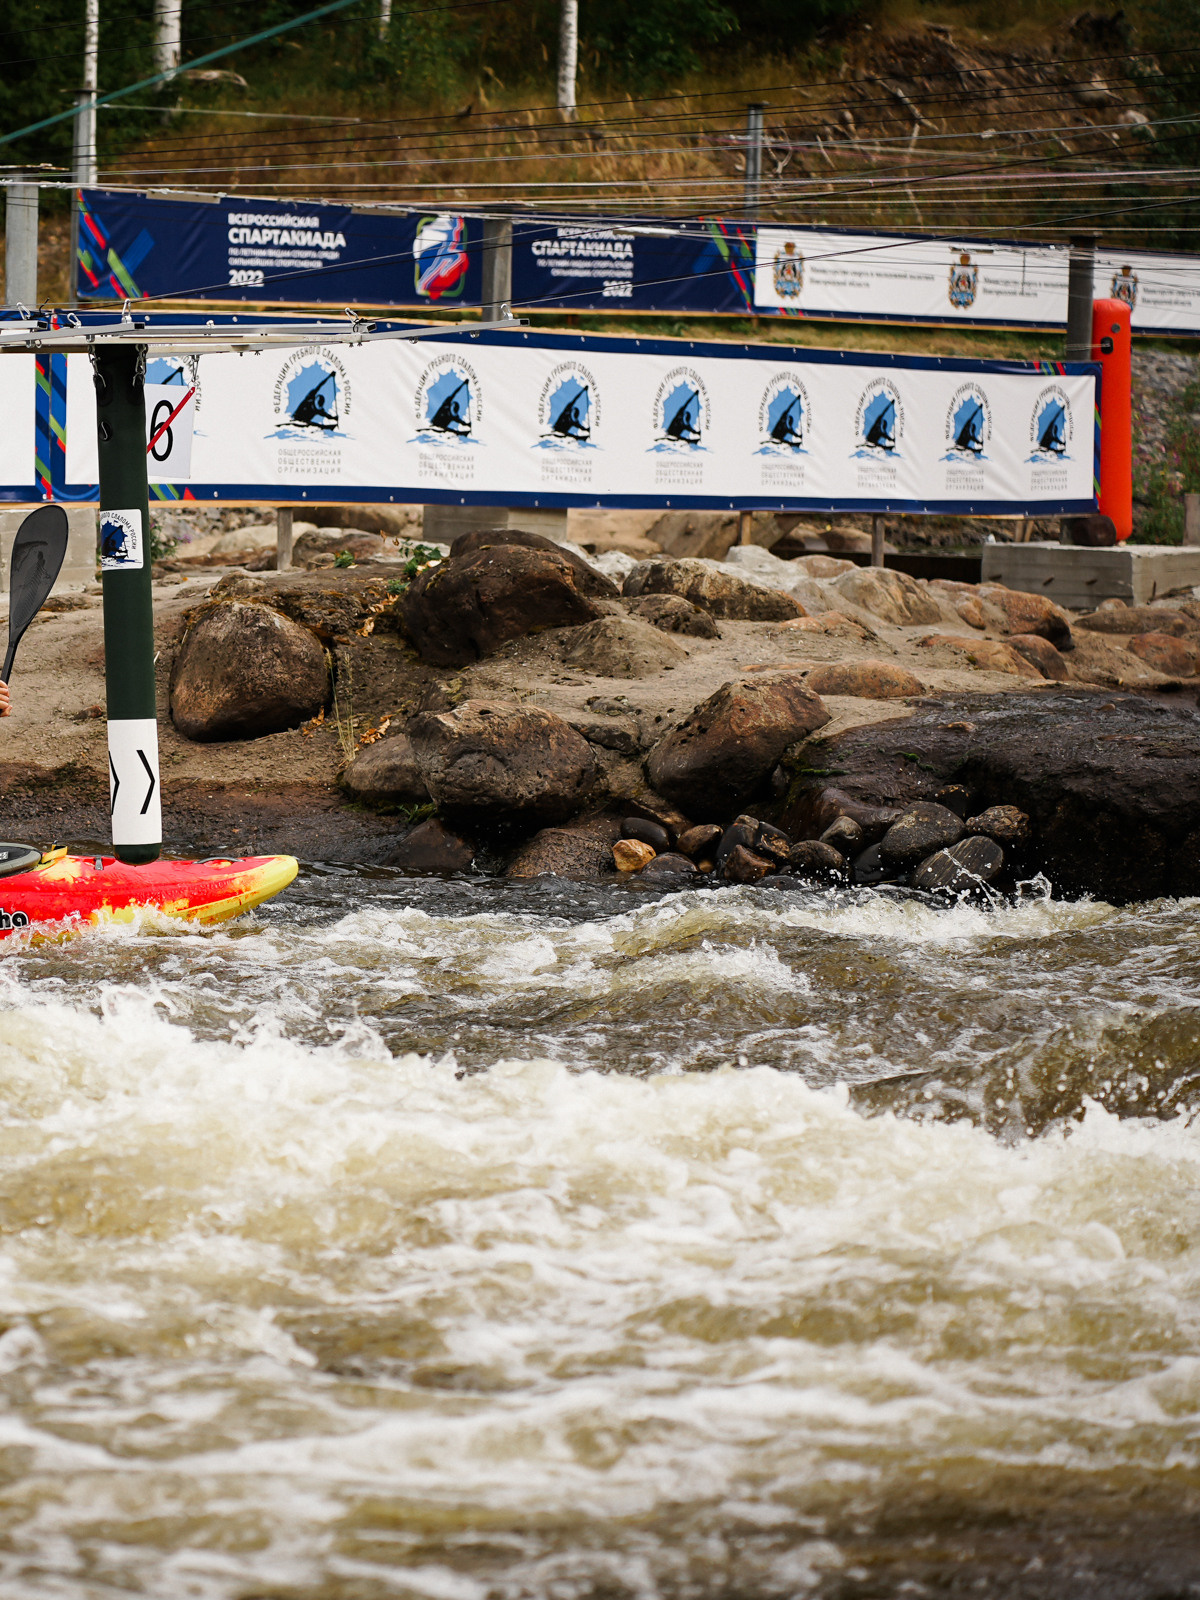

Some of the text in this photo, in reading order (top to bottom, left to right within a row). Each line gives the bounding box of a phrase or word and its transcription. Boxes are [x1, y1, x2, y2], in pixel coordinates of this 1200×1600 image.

[228, 213, 320, 228] ВСЕРОССИЙСКАЯ
[228, 227, 346, 250] СПАРТАКИАДА
[532, 241, 634, 260] СПАРТАКИАДА
[228, 270, 264, 287] 2022
[274, 346, 352, 415] ФЕДЕРАЦИЯ ГРЕБНОГО СЛАЛОМА РОССИИ
[150, 400, 174, 462] 6
